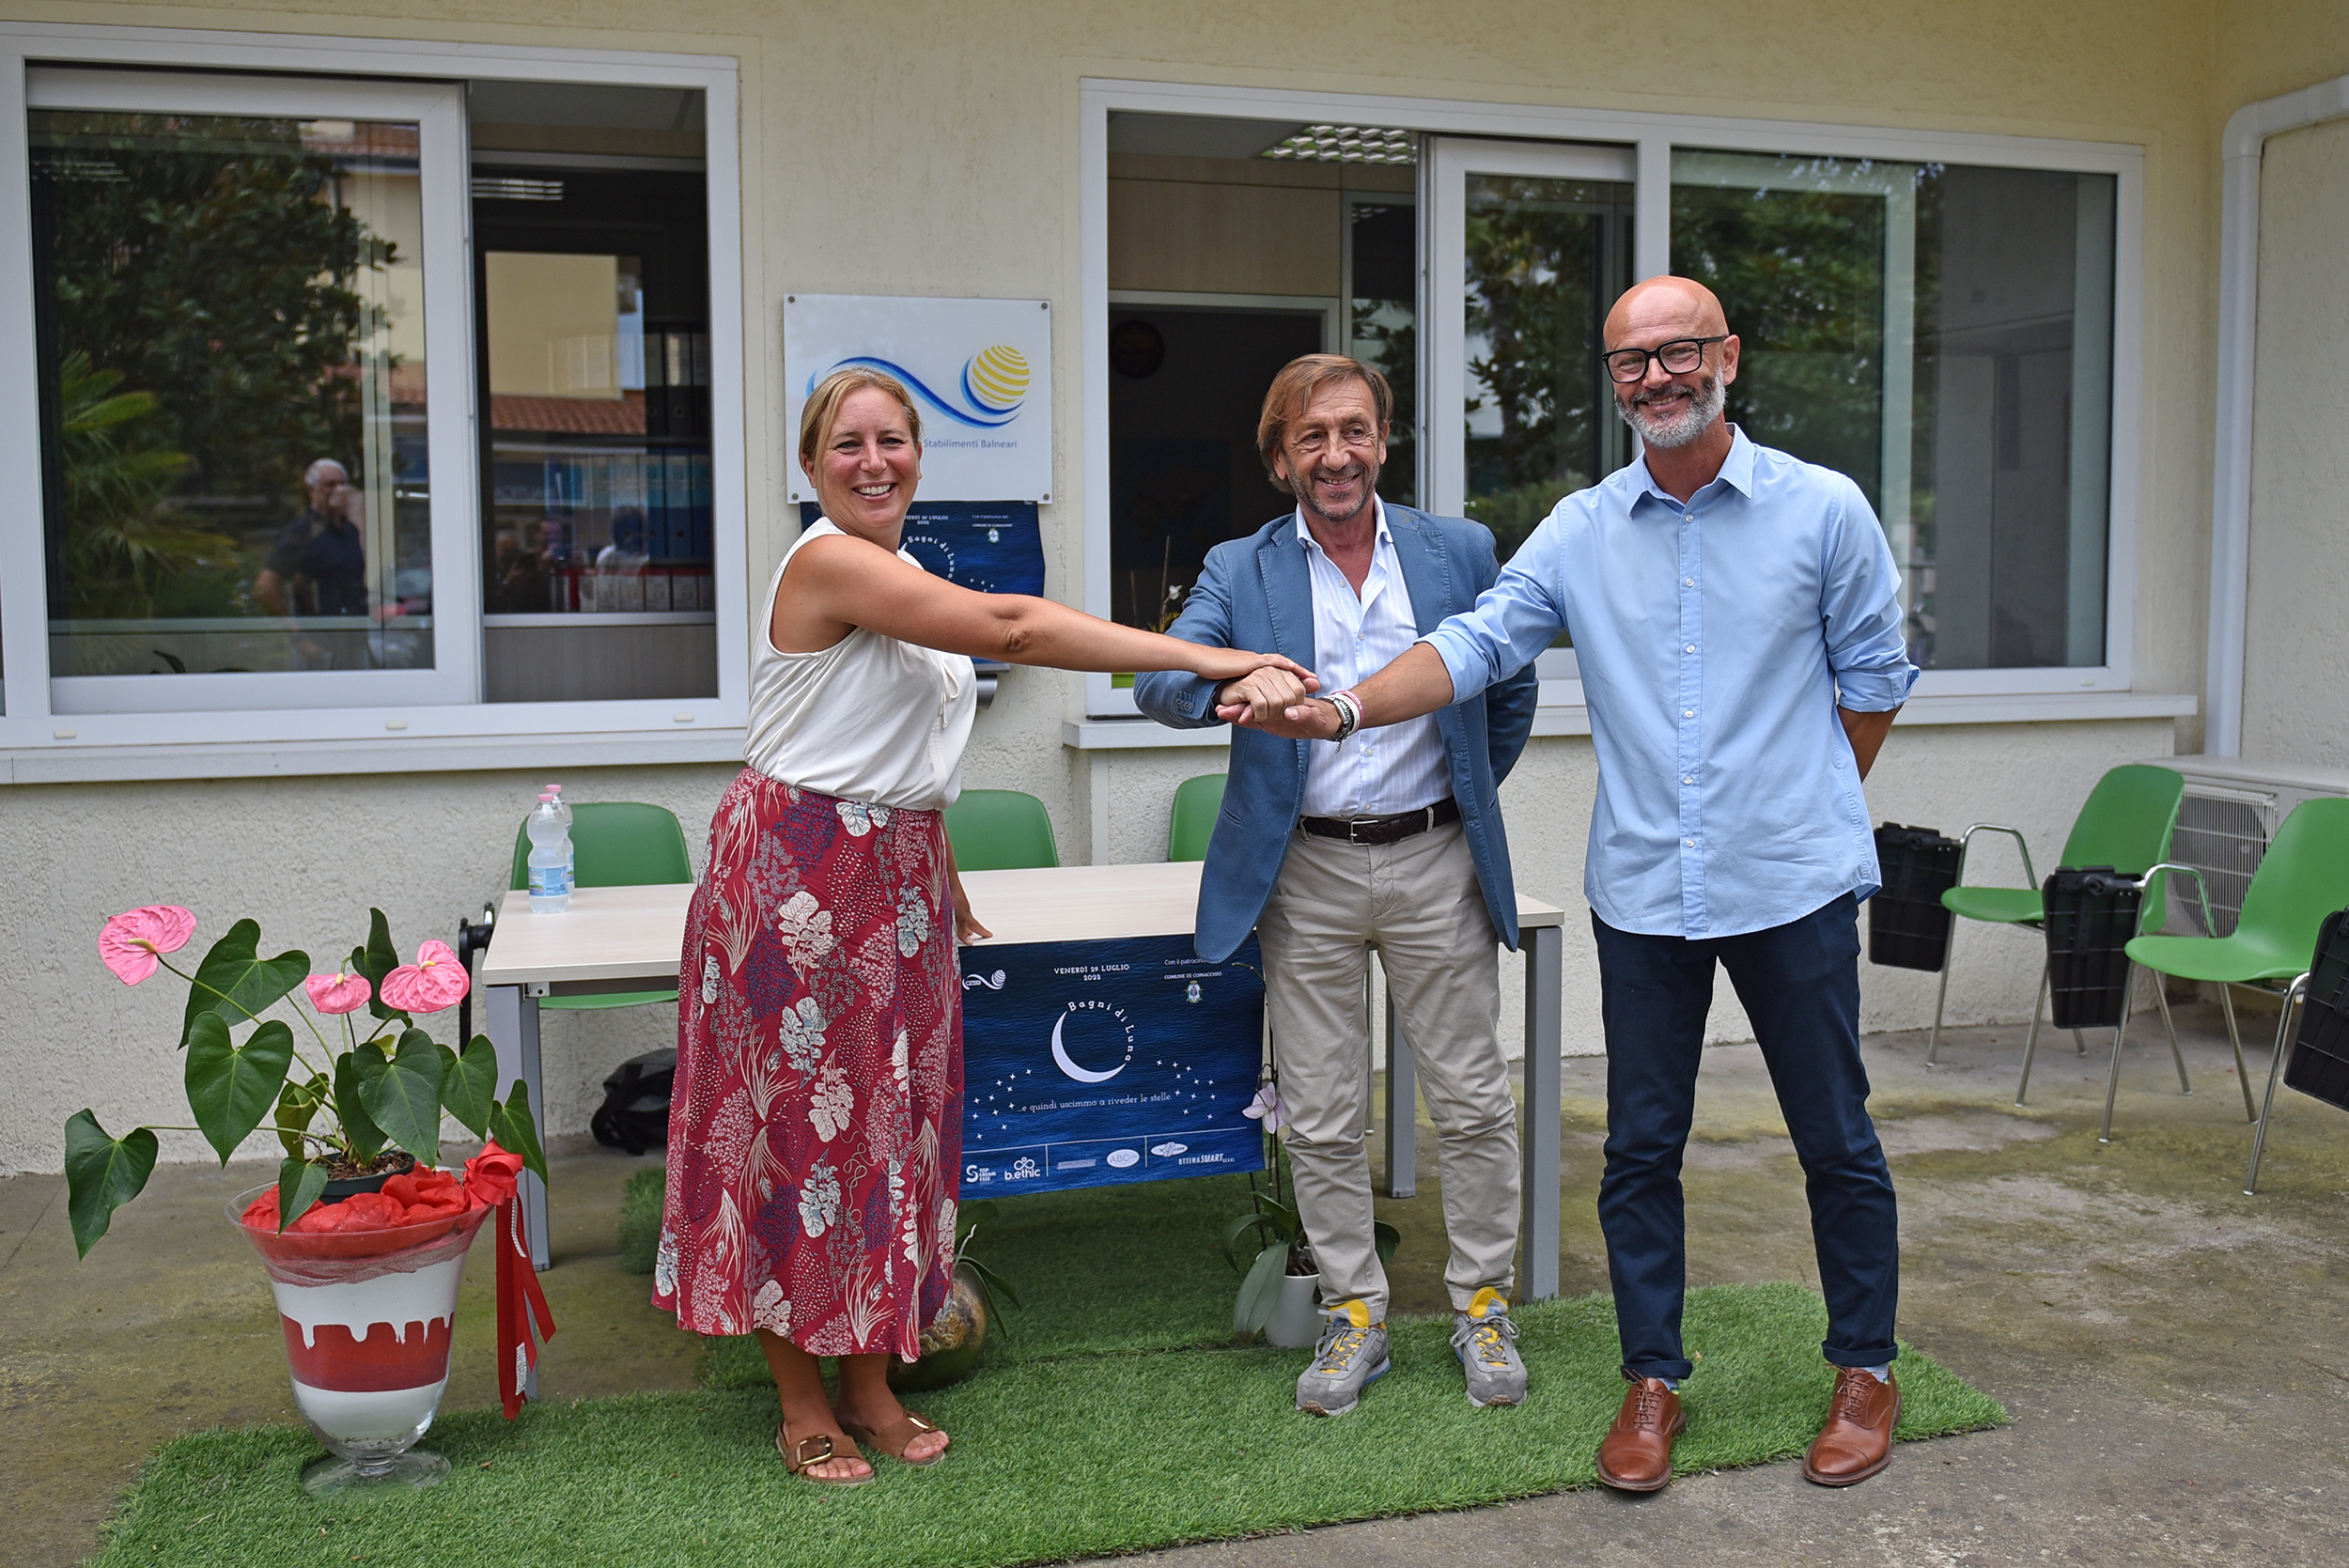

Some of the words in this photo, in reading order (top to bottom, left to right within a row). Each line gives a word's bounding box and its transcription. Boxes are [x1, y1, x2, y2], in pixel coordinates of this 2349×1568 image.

[923, 439, 978, 449] Stabilimenti
[980, 439, 1018, 449] Balneari
[907, 536, 939, 544] Bagni
[939, 542, 950, 552] di
[1053, 965, 1088, 975] VENERDÌ
[1100, 963, 1130, 972] LUGLIO
[1192, 970, 1222, 979] COMACCHIO
[1082, 973, 1101, 982] 2022
[1067, 1000, 1112, 1012] Bagni
[1114, 1008, 1128, 1023] di
[1124, 1024, 1135, 1062] Luna
[1029, 1099, 1057, 1113] quindi
[1059, 1099, 1097, 1109] uscimmo
[1107, 1094, 1138, 1106] riveder
[1140, 1093, 1148, 1103] le
[1150, 1091, 1173, 1102] stelle.
[1109, 1154, 1130, 1164] ABC
[1003, 1168, 1041, 1181] b.ethic
